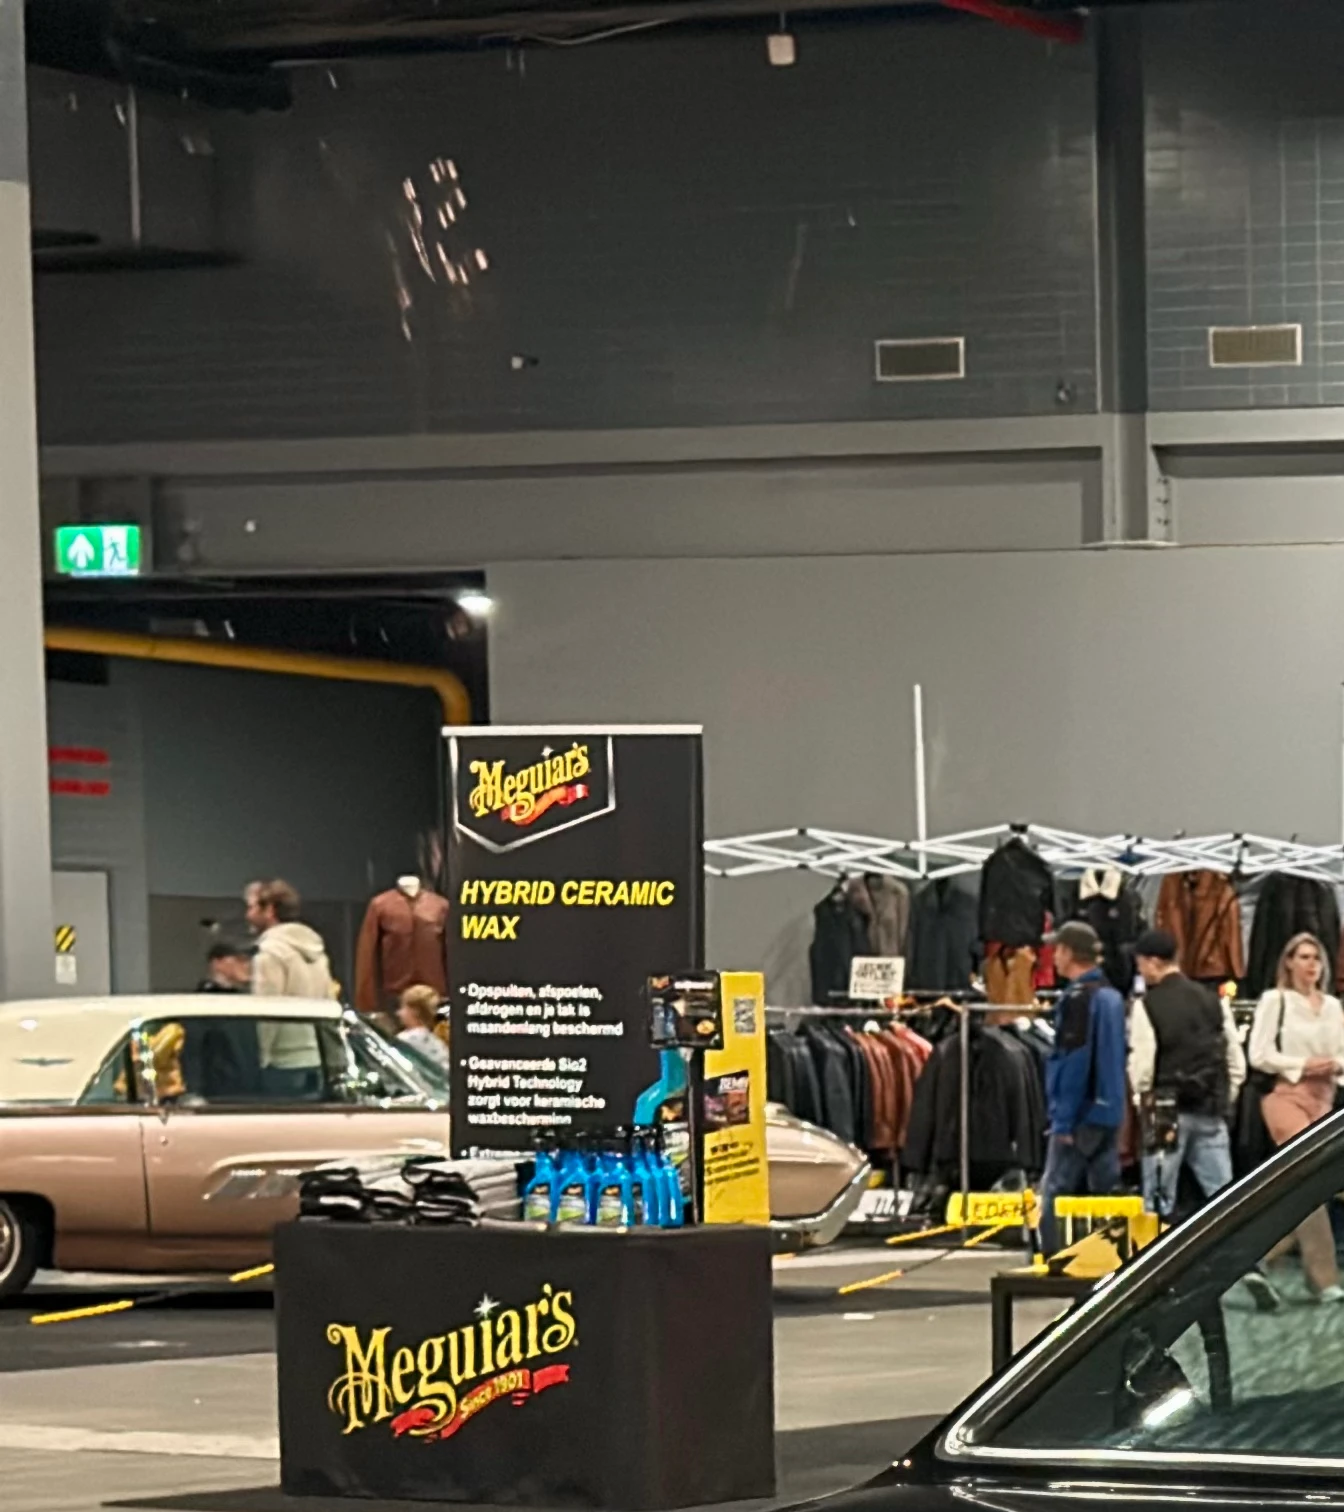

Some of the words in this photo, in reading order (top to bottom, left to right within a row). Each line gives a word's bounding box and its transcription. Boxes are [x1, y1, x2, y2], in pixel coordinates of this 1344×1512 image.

[469, 741, 589, 822] Meguiar's
[460, 880, 556, 906] HYBRID
[560, 880, 675, 906] CERAMIC
[461, 915, 520, 940] WAX
[327, 1283, 577, 1437] Meguiar's
